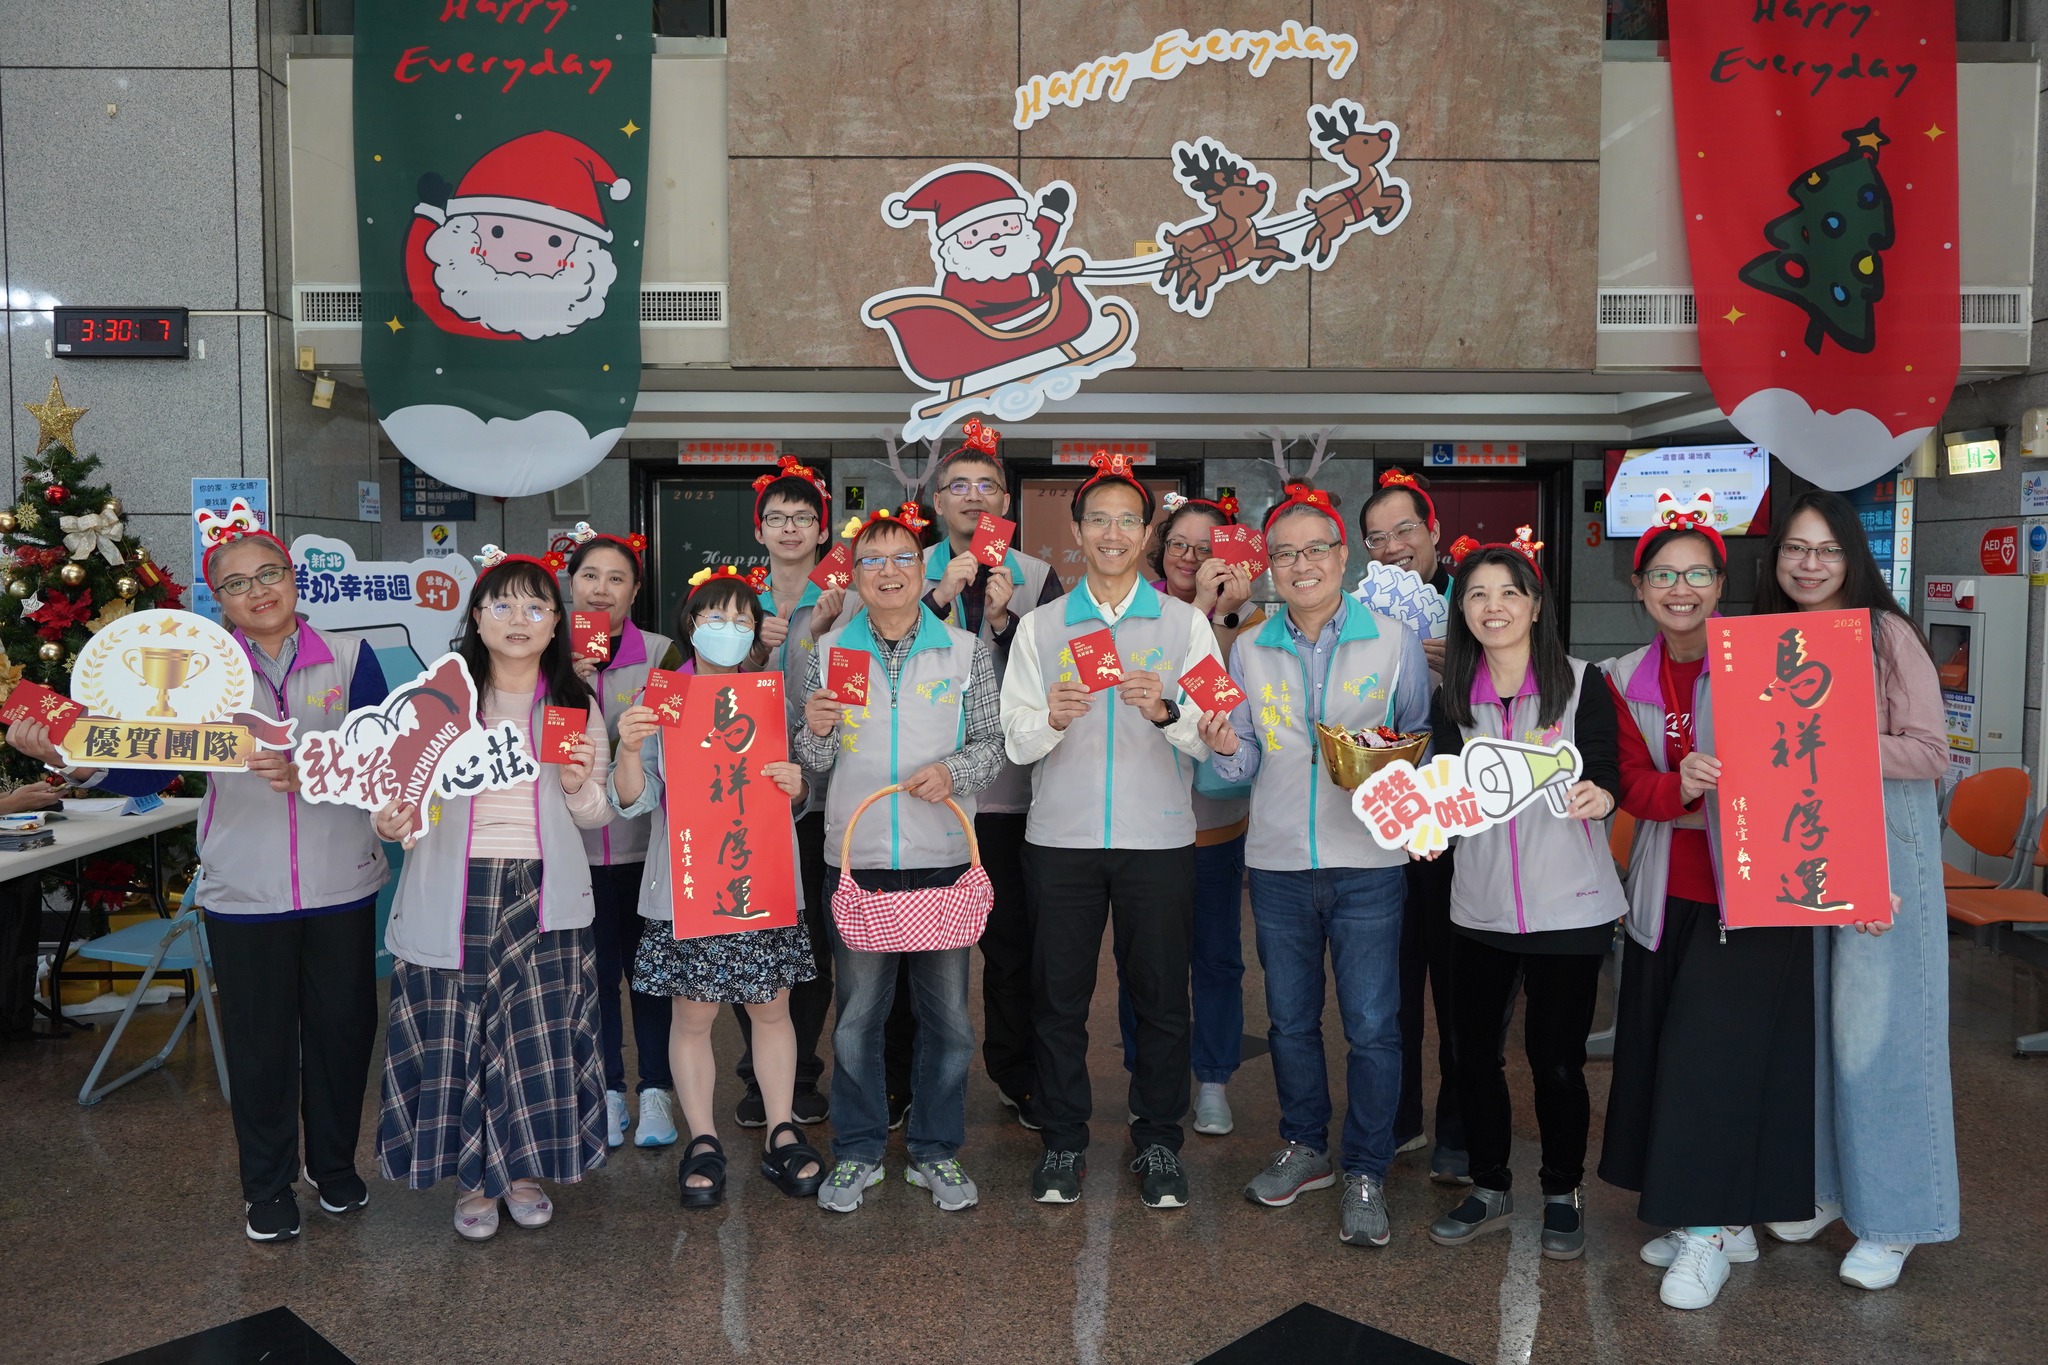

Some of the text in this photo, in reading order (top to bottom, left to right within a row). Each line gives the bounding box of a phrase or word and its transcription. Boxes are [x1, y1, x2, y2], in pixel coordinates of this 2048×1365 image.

[1151, 27, 1354, 73] Everyday
[394, 46, 612, 94] Everyday
[1710, 46, 1918, 98] Everyday
[673, 490, 715, 500] 2025
[1900, 479, 1914, 495] 10
[1902, 508, 1909, 525] 9
[1586, 521, 1601, 547] 3
[2003, 536, 2014, 544] AED
[1900, 537, 1909, 555] 8
[1984, 540, 2000, 551] AED
[311, 553, 342, 568] 新北
[1900, 568, 1907, 585] 7
[1936, 584, 1952, 592] AED
[426, 589, 448, 608] +1
[1834, 619, 1861, 628] 2026
[84, 725, 239, 762] 優質團隊
[403, 721, 461, 807] XINZHUANG
[1759, 627, 1854, 911] 馬祥厚運
[700, 686, 771, 920] 馬祥厚運
[1361, 769, 1484, 841] 讚啦
